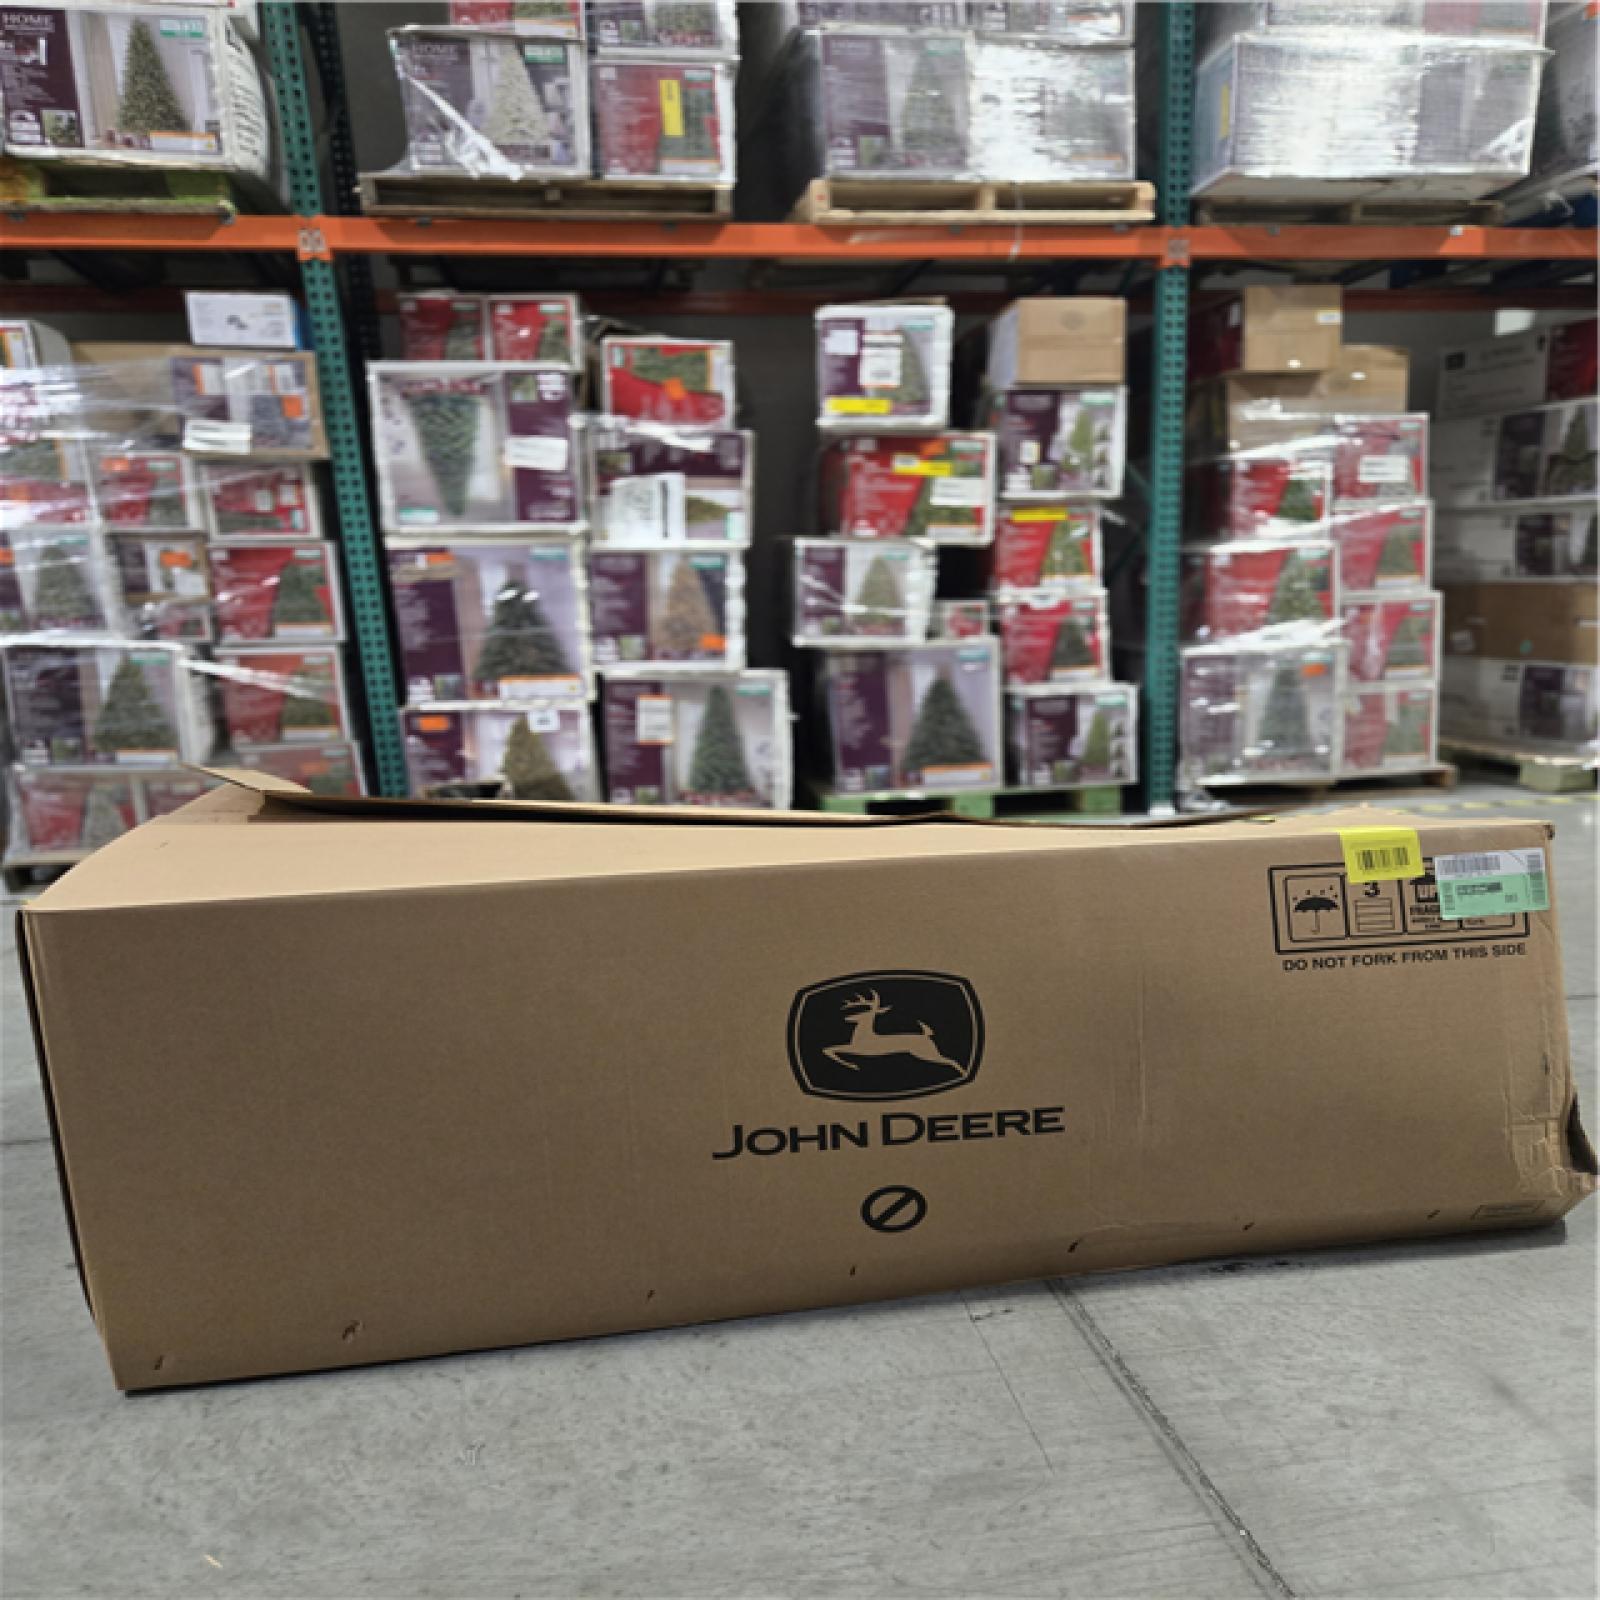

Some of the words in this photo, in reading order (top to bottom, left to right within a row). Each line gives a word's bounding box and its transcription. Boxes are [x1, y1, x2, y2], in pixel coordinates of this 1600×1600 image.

[1282, 959, 1307, 971] DO
[1312, 956, 1347, 970] NOT
[1352, 952, 1396, 967] FORK
[1402, 949, 1448, 963] FROM
[1453, 946, 1488, 960] THIS
[1492, 943, 1526, 957] SIDE
[712, 1120, 868, 1160] JOHN
[881, 1106, 1065, 1145] DEERE
